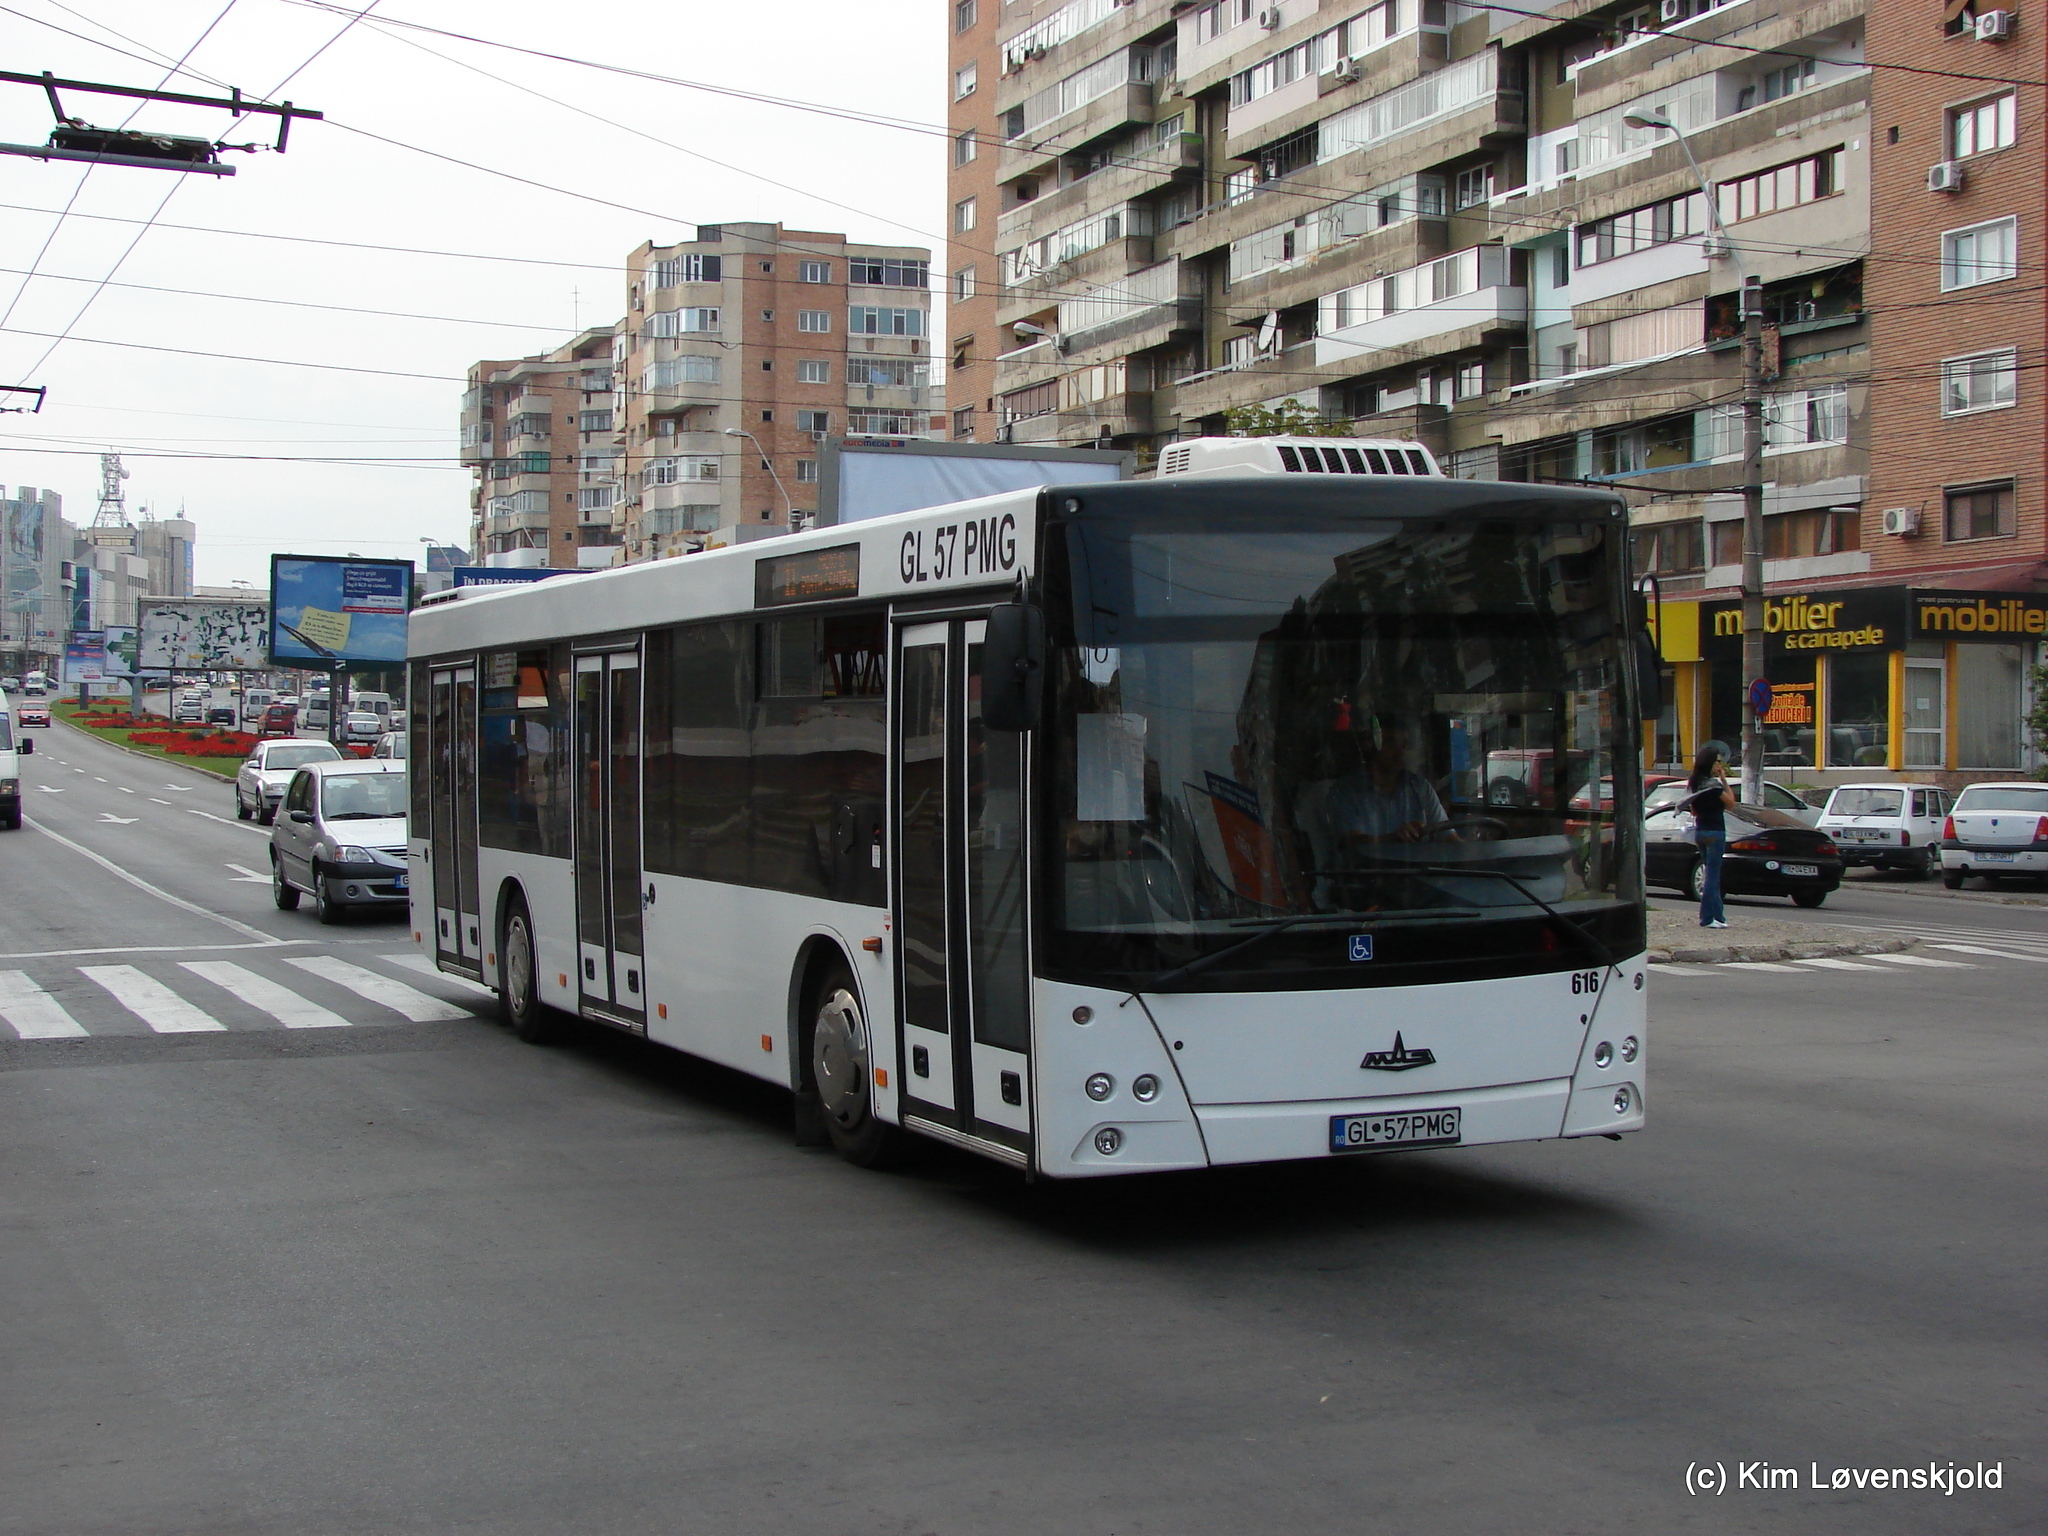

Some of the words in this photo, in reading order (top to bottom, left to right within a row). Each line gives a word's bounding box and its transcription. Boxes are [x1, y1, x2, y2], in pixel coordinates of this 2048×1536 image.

[900, 530, 928, 584] GL
[933, 524, 958, 580] 57
[964, 512, 1016, 571] PMG
[1714, 594, 1845, 636] mbilier
[1921, 599, 2048, 634] mobilie
[1572, 971, 1599, 995] 616
[1335, 1134, 1345, 1145] RO
